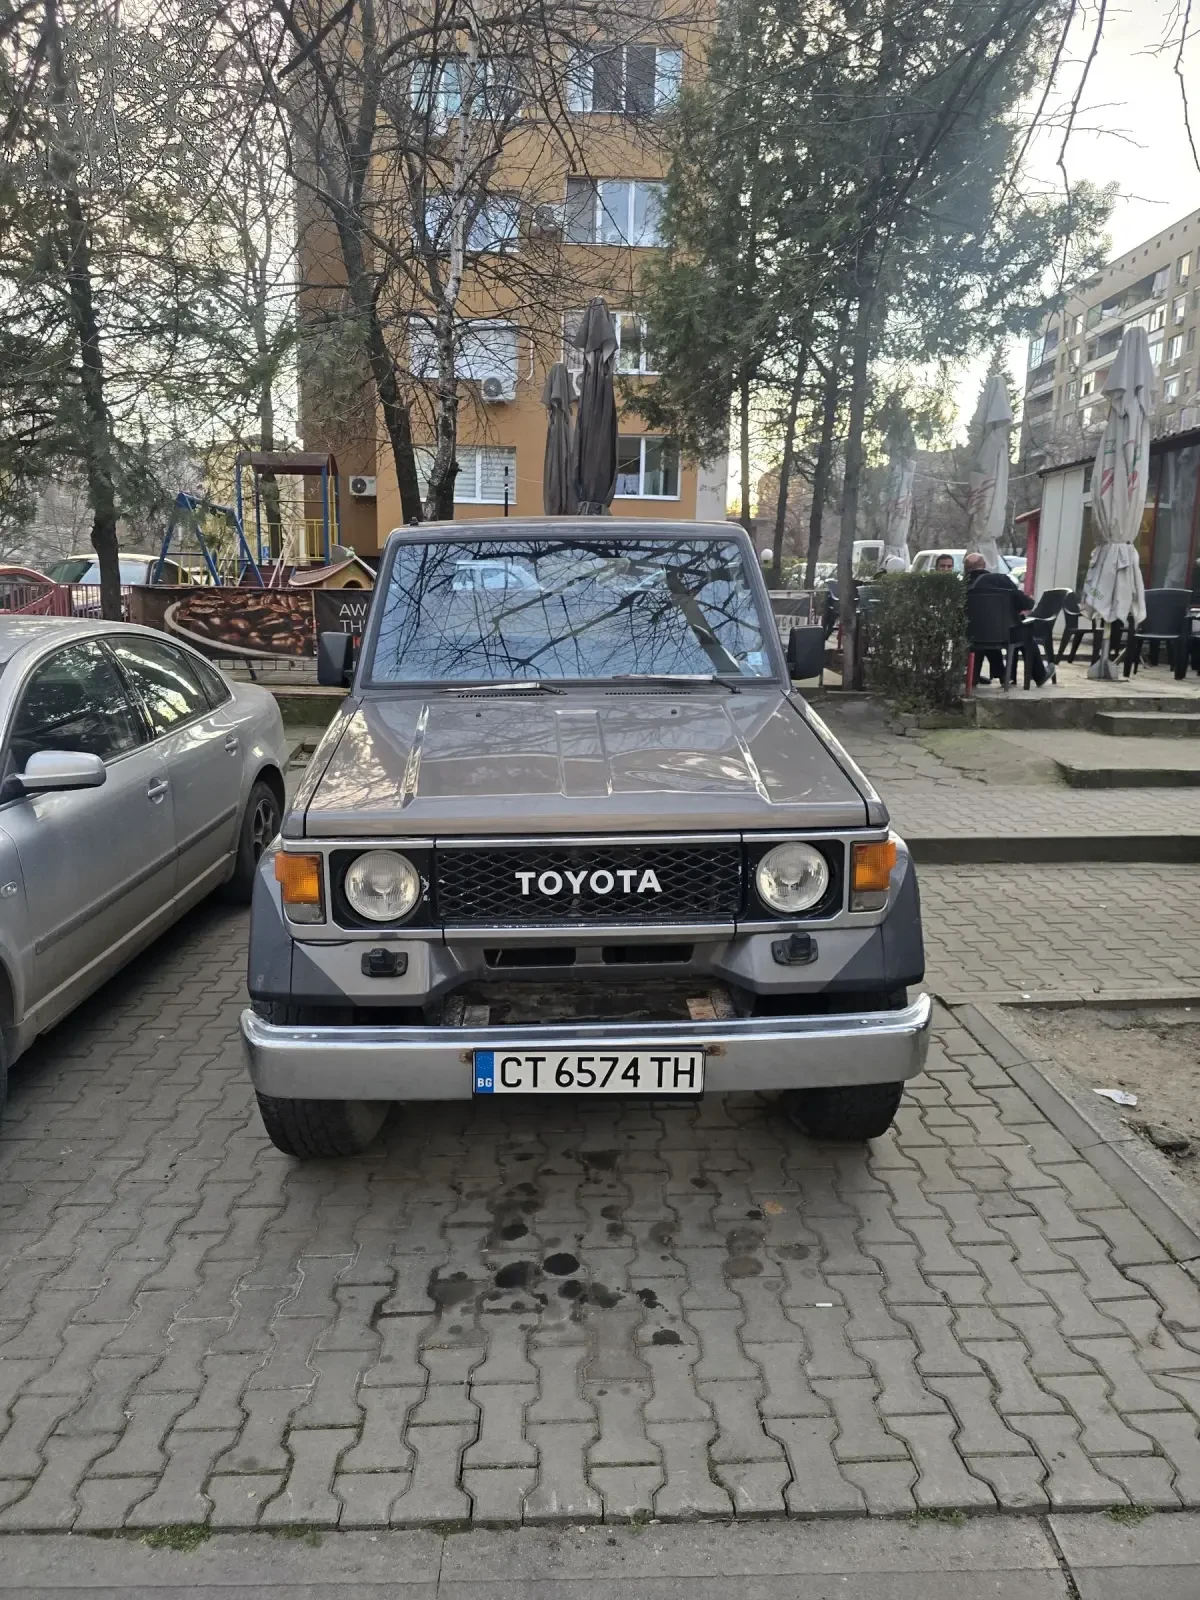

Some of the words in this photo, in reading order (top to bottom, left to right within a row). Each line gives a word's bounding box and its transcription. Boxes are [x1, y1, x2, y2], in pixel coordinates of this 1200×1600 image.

[339, 619, 366, 633] TH
[515, 869, 663, 896] TOYOTA
[500, 1056, 546, 1088] CT
[555, 1056, 641, 1088] 6574
[650, 1056, 695, 1088] TH
[477, 1077, 493, 1089] BG
